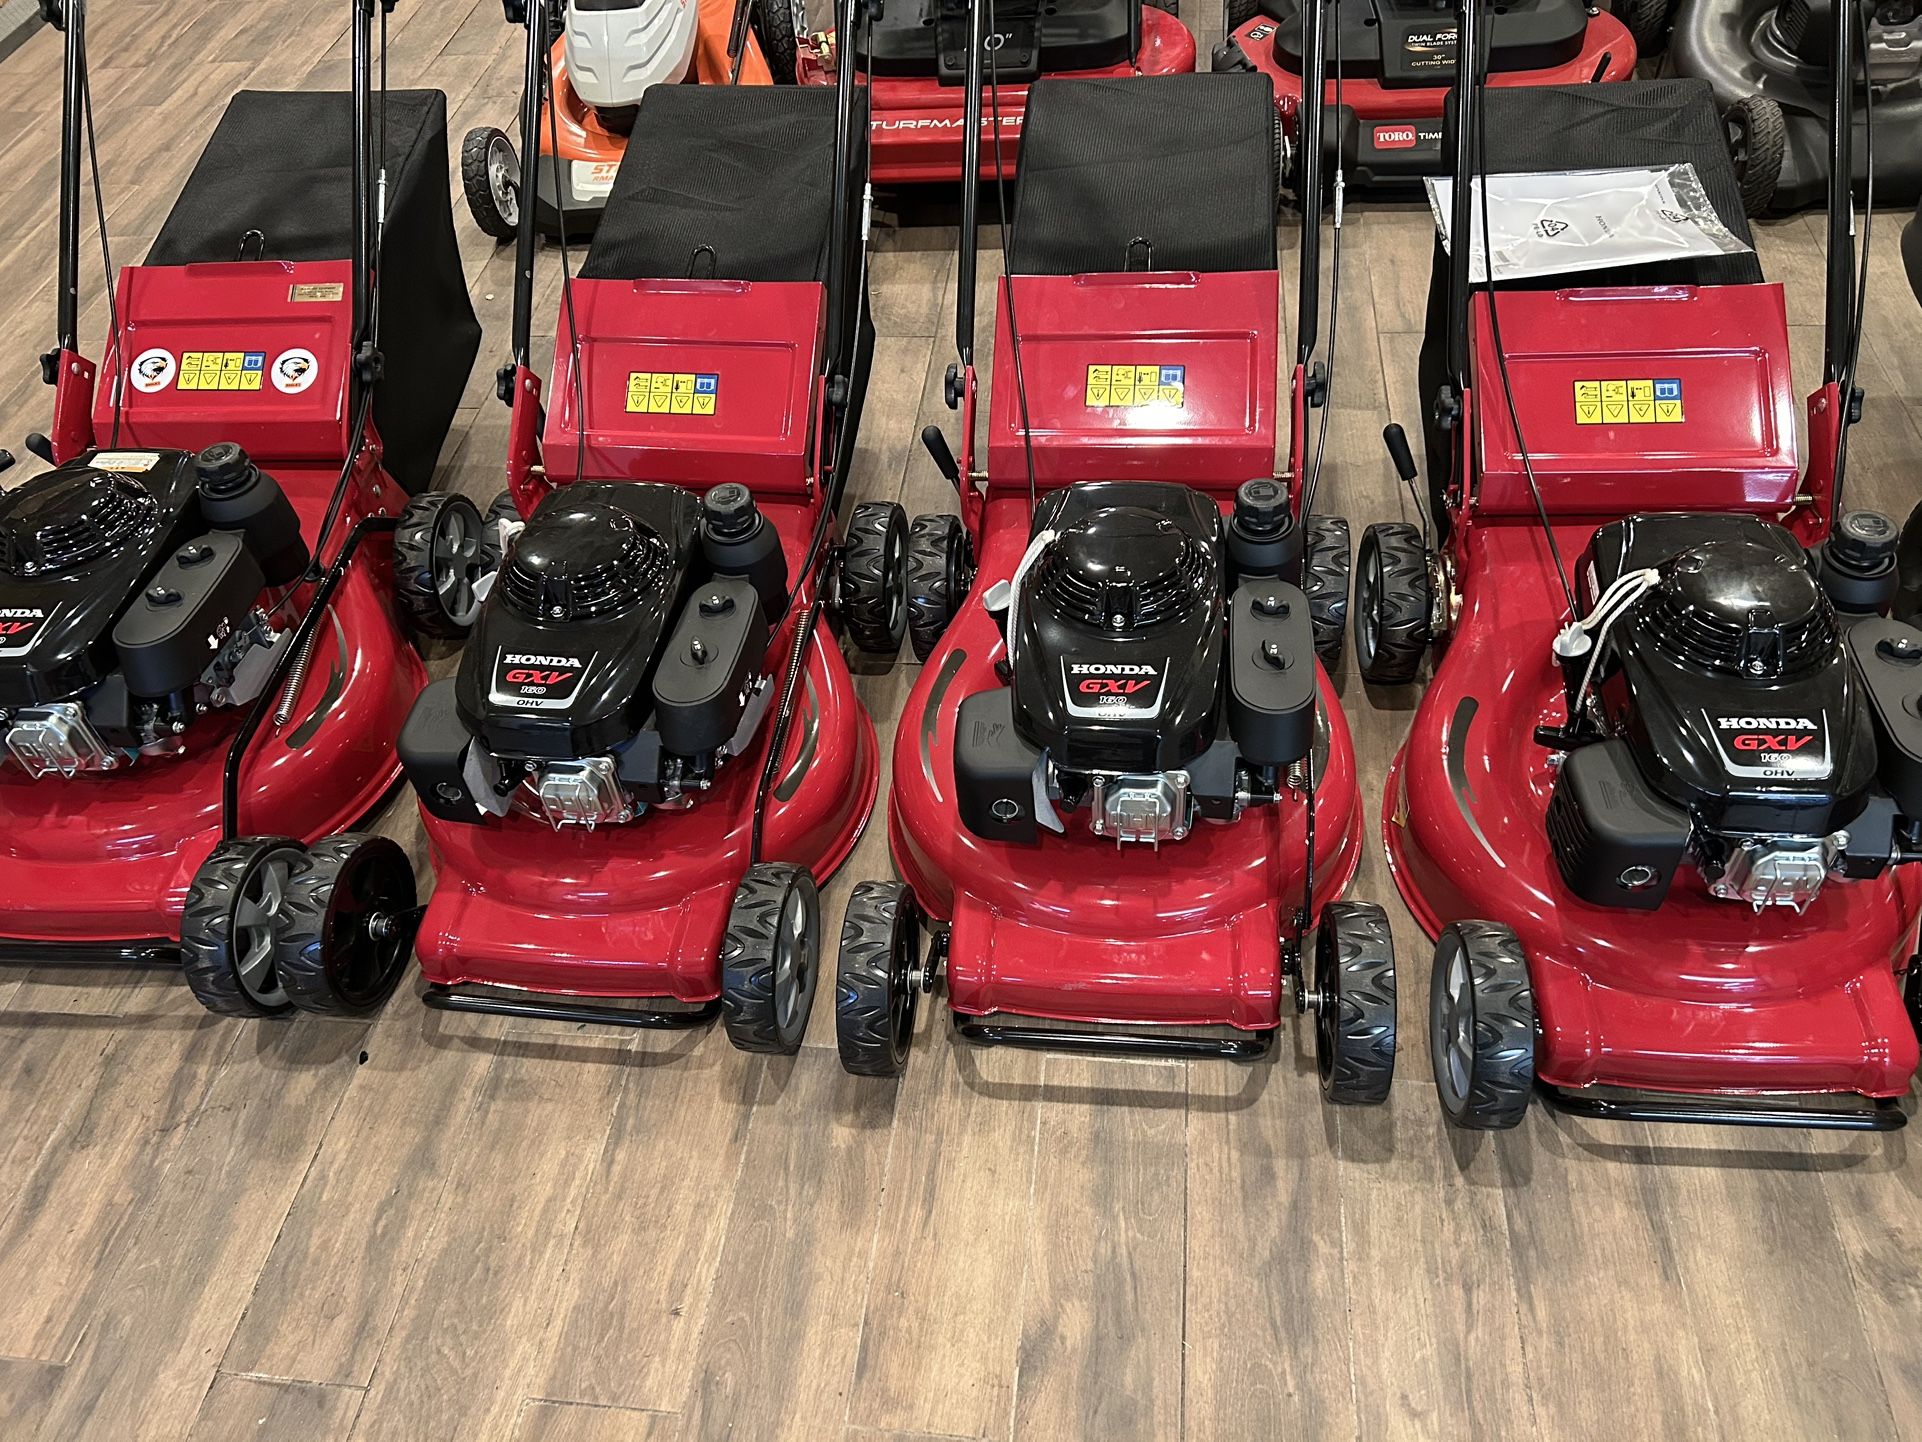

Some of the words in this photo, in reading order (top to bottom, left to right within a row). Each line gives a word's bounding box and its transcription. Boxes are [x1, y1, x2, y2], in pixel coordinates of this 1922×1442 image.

[1408, 34, 1433, 42] DUAL
[1436, 33, 1458, 41] FOR
[592, 164, 619, 174] ST
[0, 609, 44, 618] NDA
[503, 654, 582, 668] HONDA
[1071, 664, 1158, 675] HONDA
[506, 669, 574, 684] GXV
[520, 685, 547, 695] 160
[1079, 679, 1151, 693] GXV
[516, 699, 544, 707] OHV
[1099, 695, 1127, 704] 160
[1717, 717, 1818, 730] HONDA
[1733, 734, 1814, 751] GXV
[1760, 752, 1792, 763] 160
[1763, 769, 1795, 777] OHV
